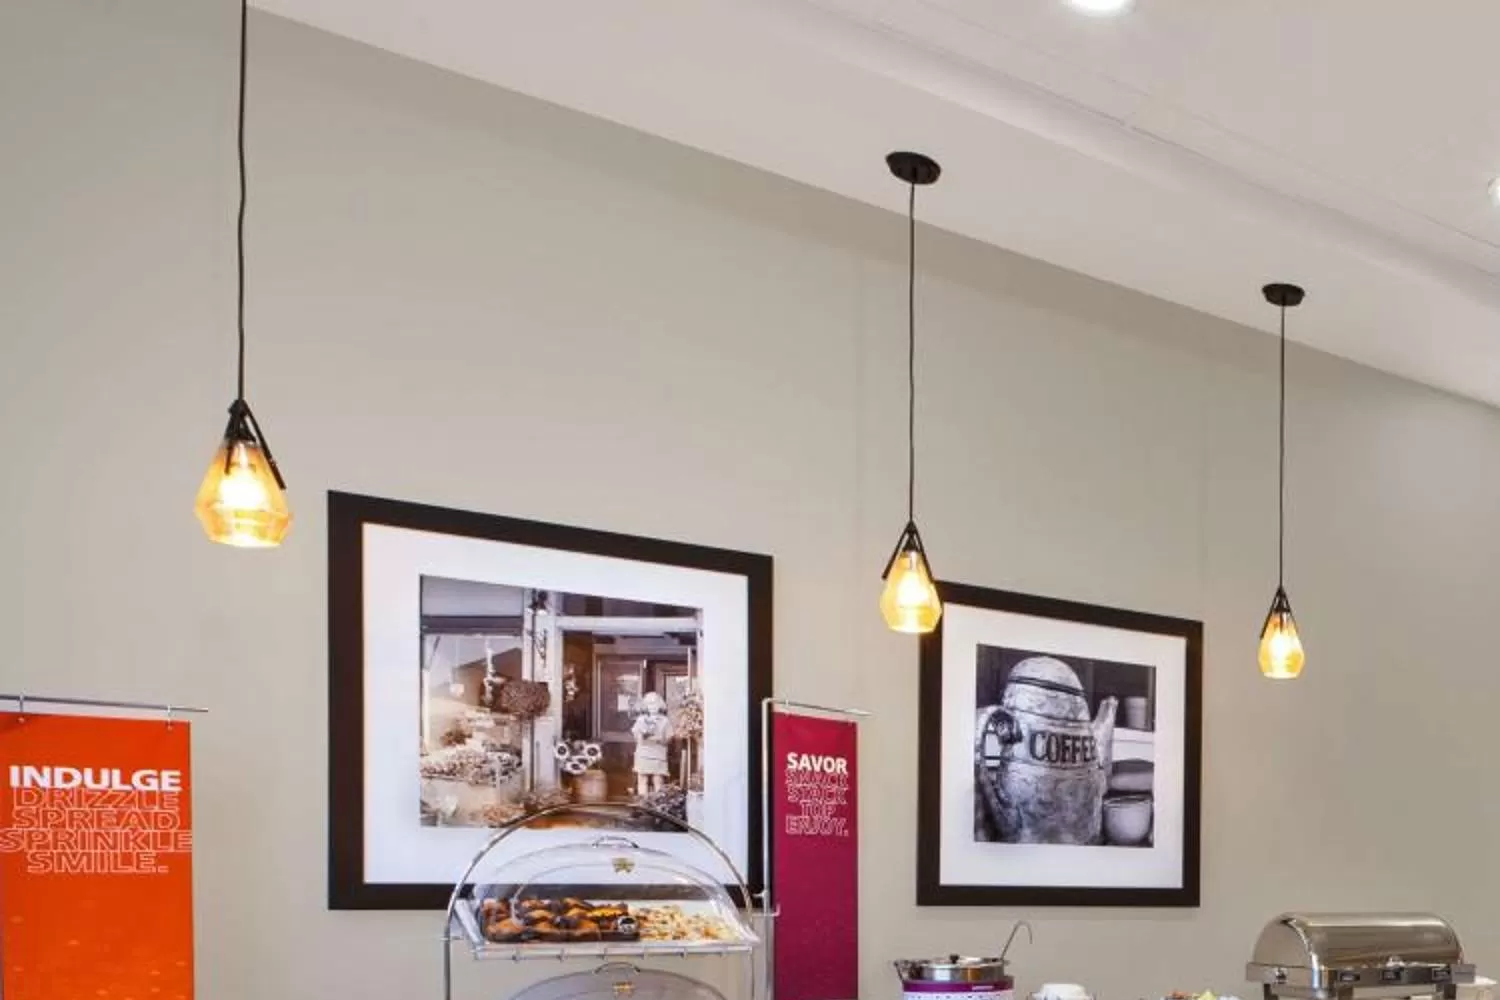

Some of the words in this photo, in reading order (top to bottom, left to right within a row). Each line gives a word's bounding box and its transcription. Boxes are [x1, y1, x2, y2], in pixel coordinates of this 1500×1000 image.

[787, 752, 848, 774] SAVOR
[9, 765, 182, 792] INDULGE
[13, 787, 180, 811] DRIZZLE
[800, 799, 836, 818] TOP
[12, 808, 180, 832] SPREAD
[785, 814, 849, 836] ENJOY.
[0, 827, 193, 853] SPRINKLE
[26, 850, 169, 875] SMILE.
